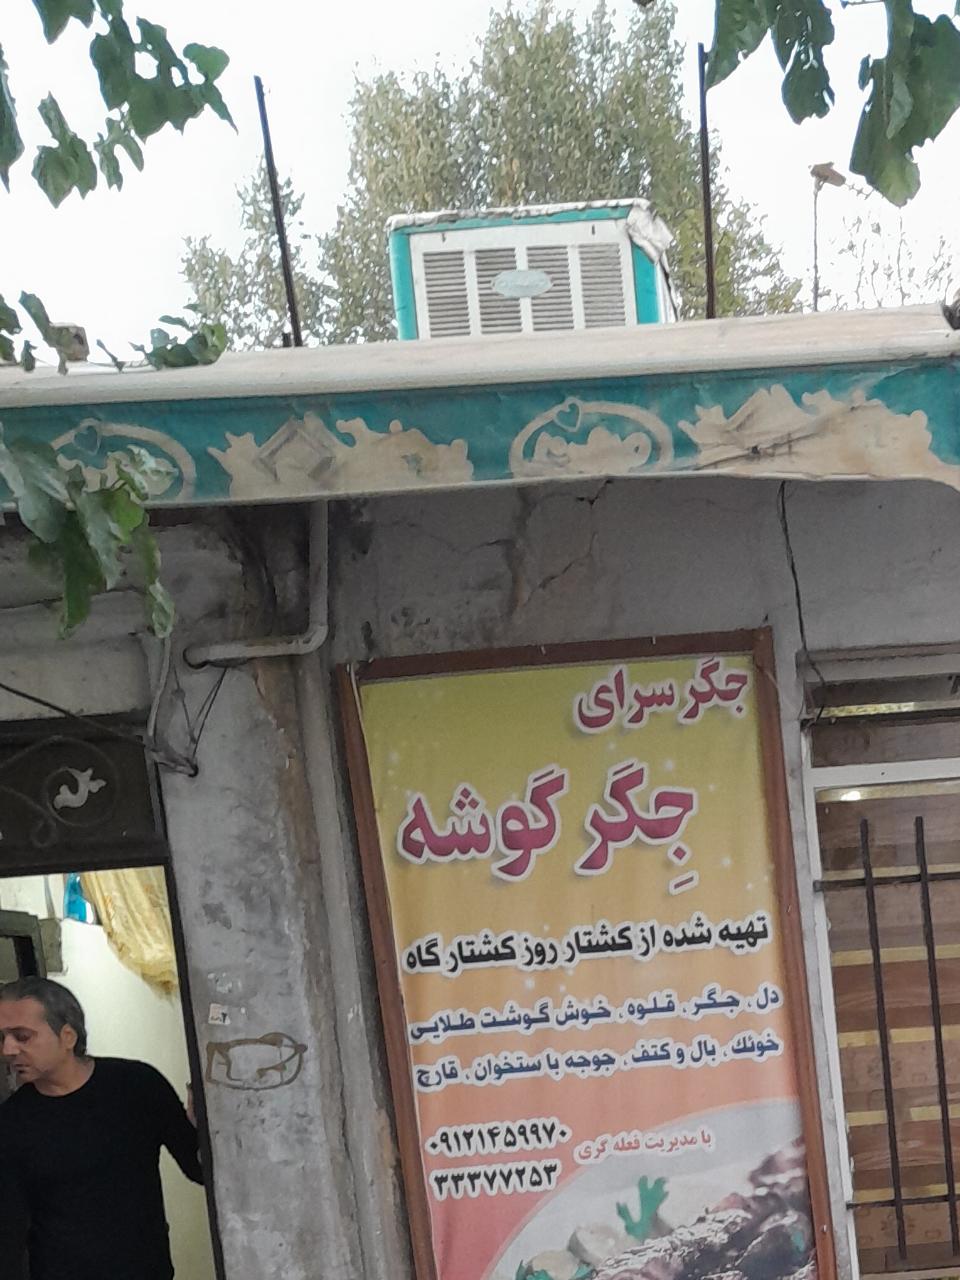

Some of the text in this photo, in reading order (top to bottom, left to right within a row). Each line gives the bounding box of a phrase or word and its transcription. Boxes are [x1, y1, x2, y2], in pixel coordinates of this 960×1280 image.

[577, 657, 748, 729] جگر سرای
[402, 768, 566, 878] گوشه
[564, 924, 633, 962] کشتار
[639, 925, 655, 956] از
[663, 917, 712, 947] شده
[718, 916, 769, 949] تهیه
[448, 934, 516, 972] کشتار
[523, 937, 558, 966] روز
[411, 1013, 475, 1039] طلایی
[480, 1003, 549, 1029] گوشت
[556, 1000, 611, 1025] خوش
[565, 1052, 616, 1074] جوجه
[676, 1047, 685, 1064] و
[691, 1040, 716, 1062] بال
[416, 1060, 458, 1088] قارچ
[430, 1121, 567, 1153] ۰۹۱۲۱۴۵۹۹۷۰
[645, 1134, 698, 1152] مدیریت
[701, 1130, 711, 1148] با
[434, 1163, 557, 1195] ۳۳۳۷۷۲۵۳
